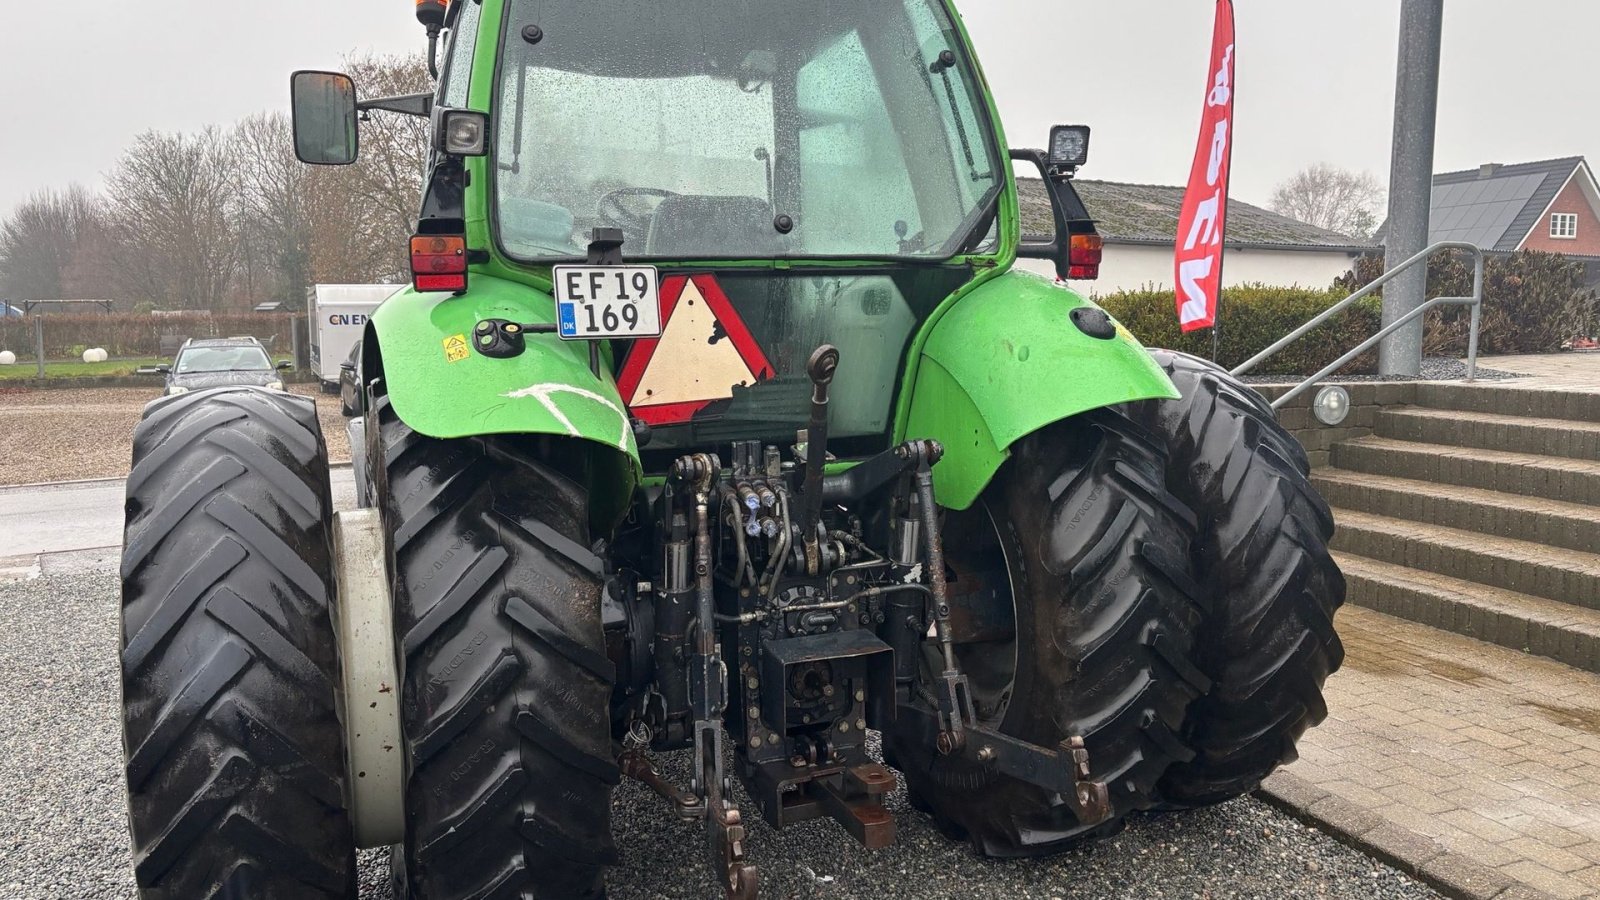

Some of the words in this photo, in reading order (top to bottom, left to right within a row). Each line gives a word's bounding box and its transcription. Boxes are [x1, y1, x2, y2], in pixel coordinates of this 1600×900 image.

[567, 272, 605, 300] EF
[615, 272, 648, 300] 19
[329, 314, 349, 326] CN
[563, 322, 575, 330] DK
[584, 303, 638, 332] 169
